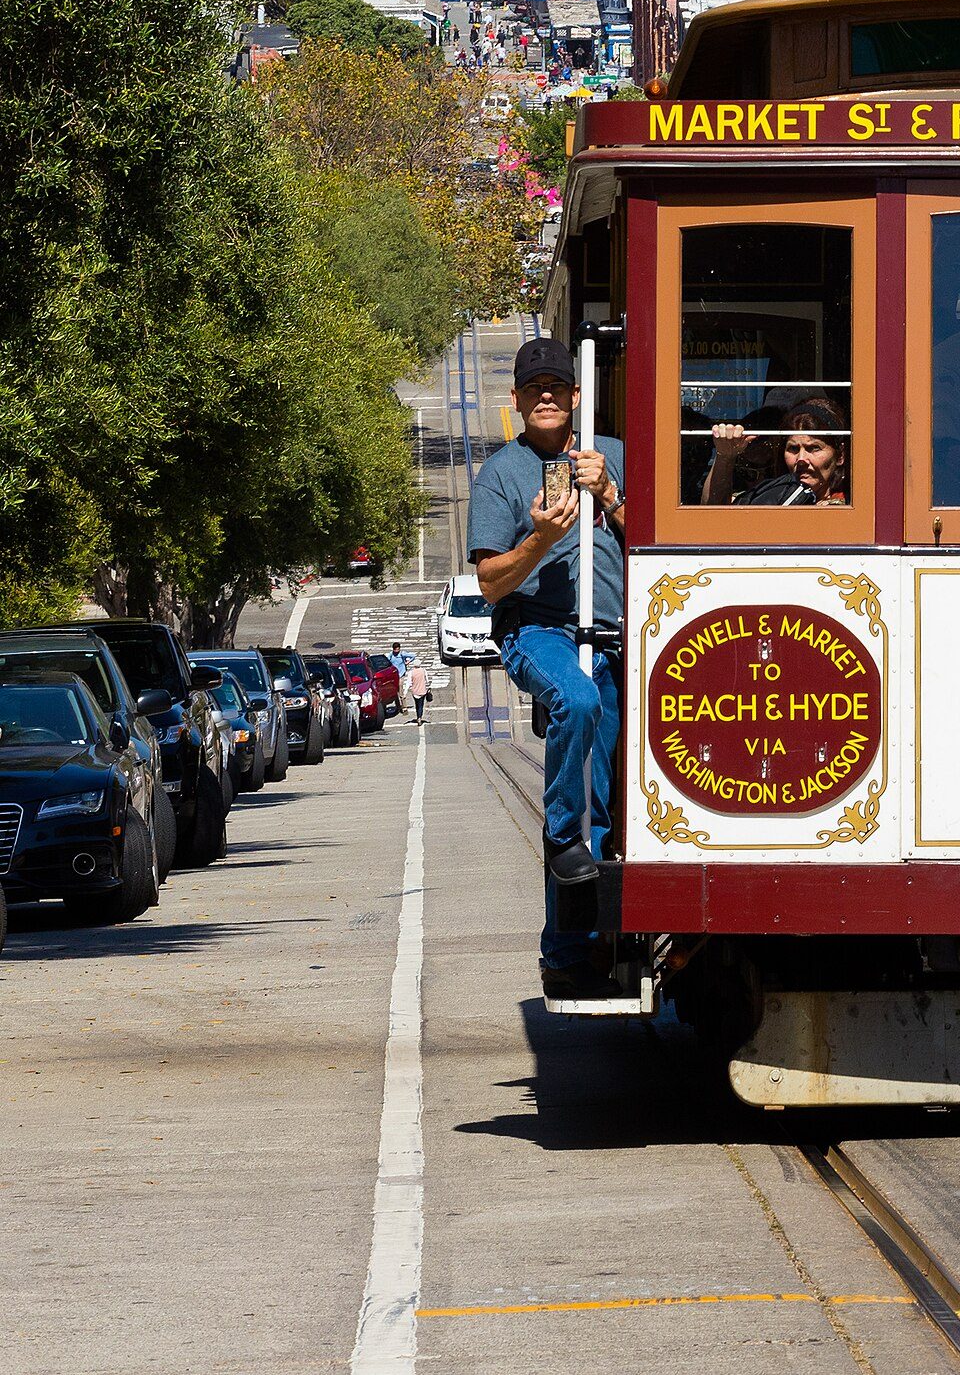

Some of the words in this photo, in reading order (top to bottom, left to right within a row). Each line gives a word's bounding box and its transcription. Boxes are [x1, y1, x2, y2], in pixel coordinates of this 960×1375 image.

[649, 103, 825, 141] MARKET
[910, 104, 938, 141] &
[711, 341, 737, 355] ONE
[741, 341, 765, 355] WAY
[665, 615, 753, 682] POWELL
[758, 614, 773, 636] &
[779, 615, 867, 680] MARKET
[748, 663, 782, 681] TO
[660, 693, 757, 722] BEACH
[764, 693, 784, 721] &
[789, 692, 870, 721] HYDE
[744, 737, 787, 756] VIA
[661, 729, 777, 805] WASHINGTON
[781, 782, 796, 805] &
[798, 730, 870, 801] JACKSON
